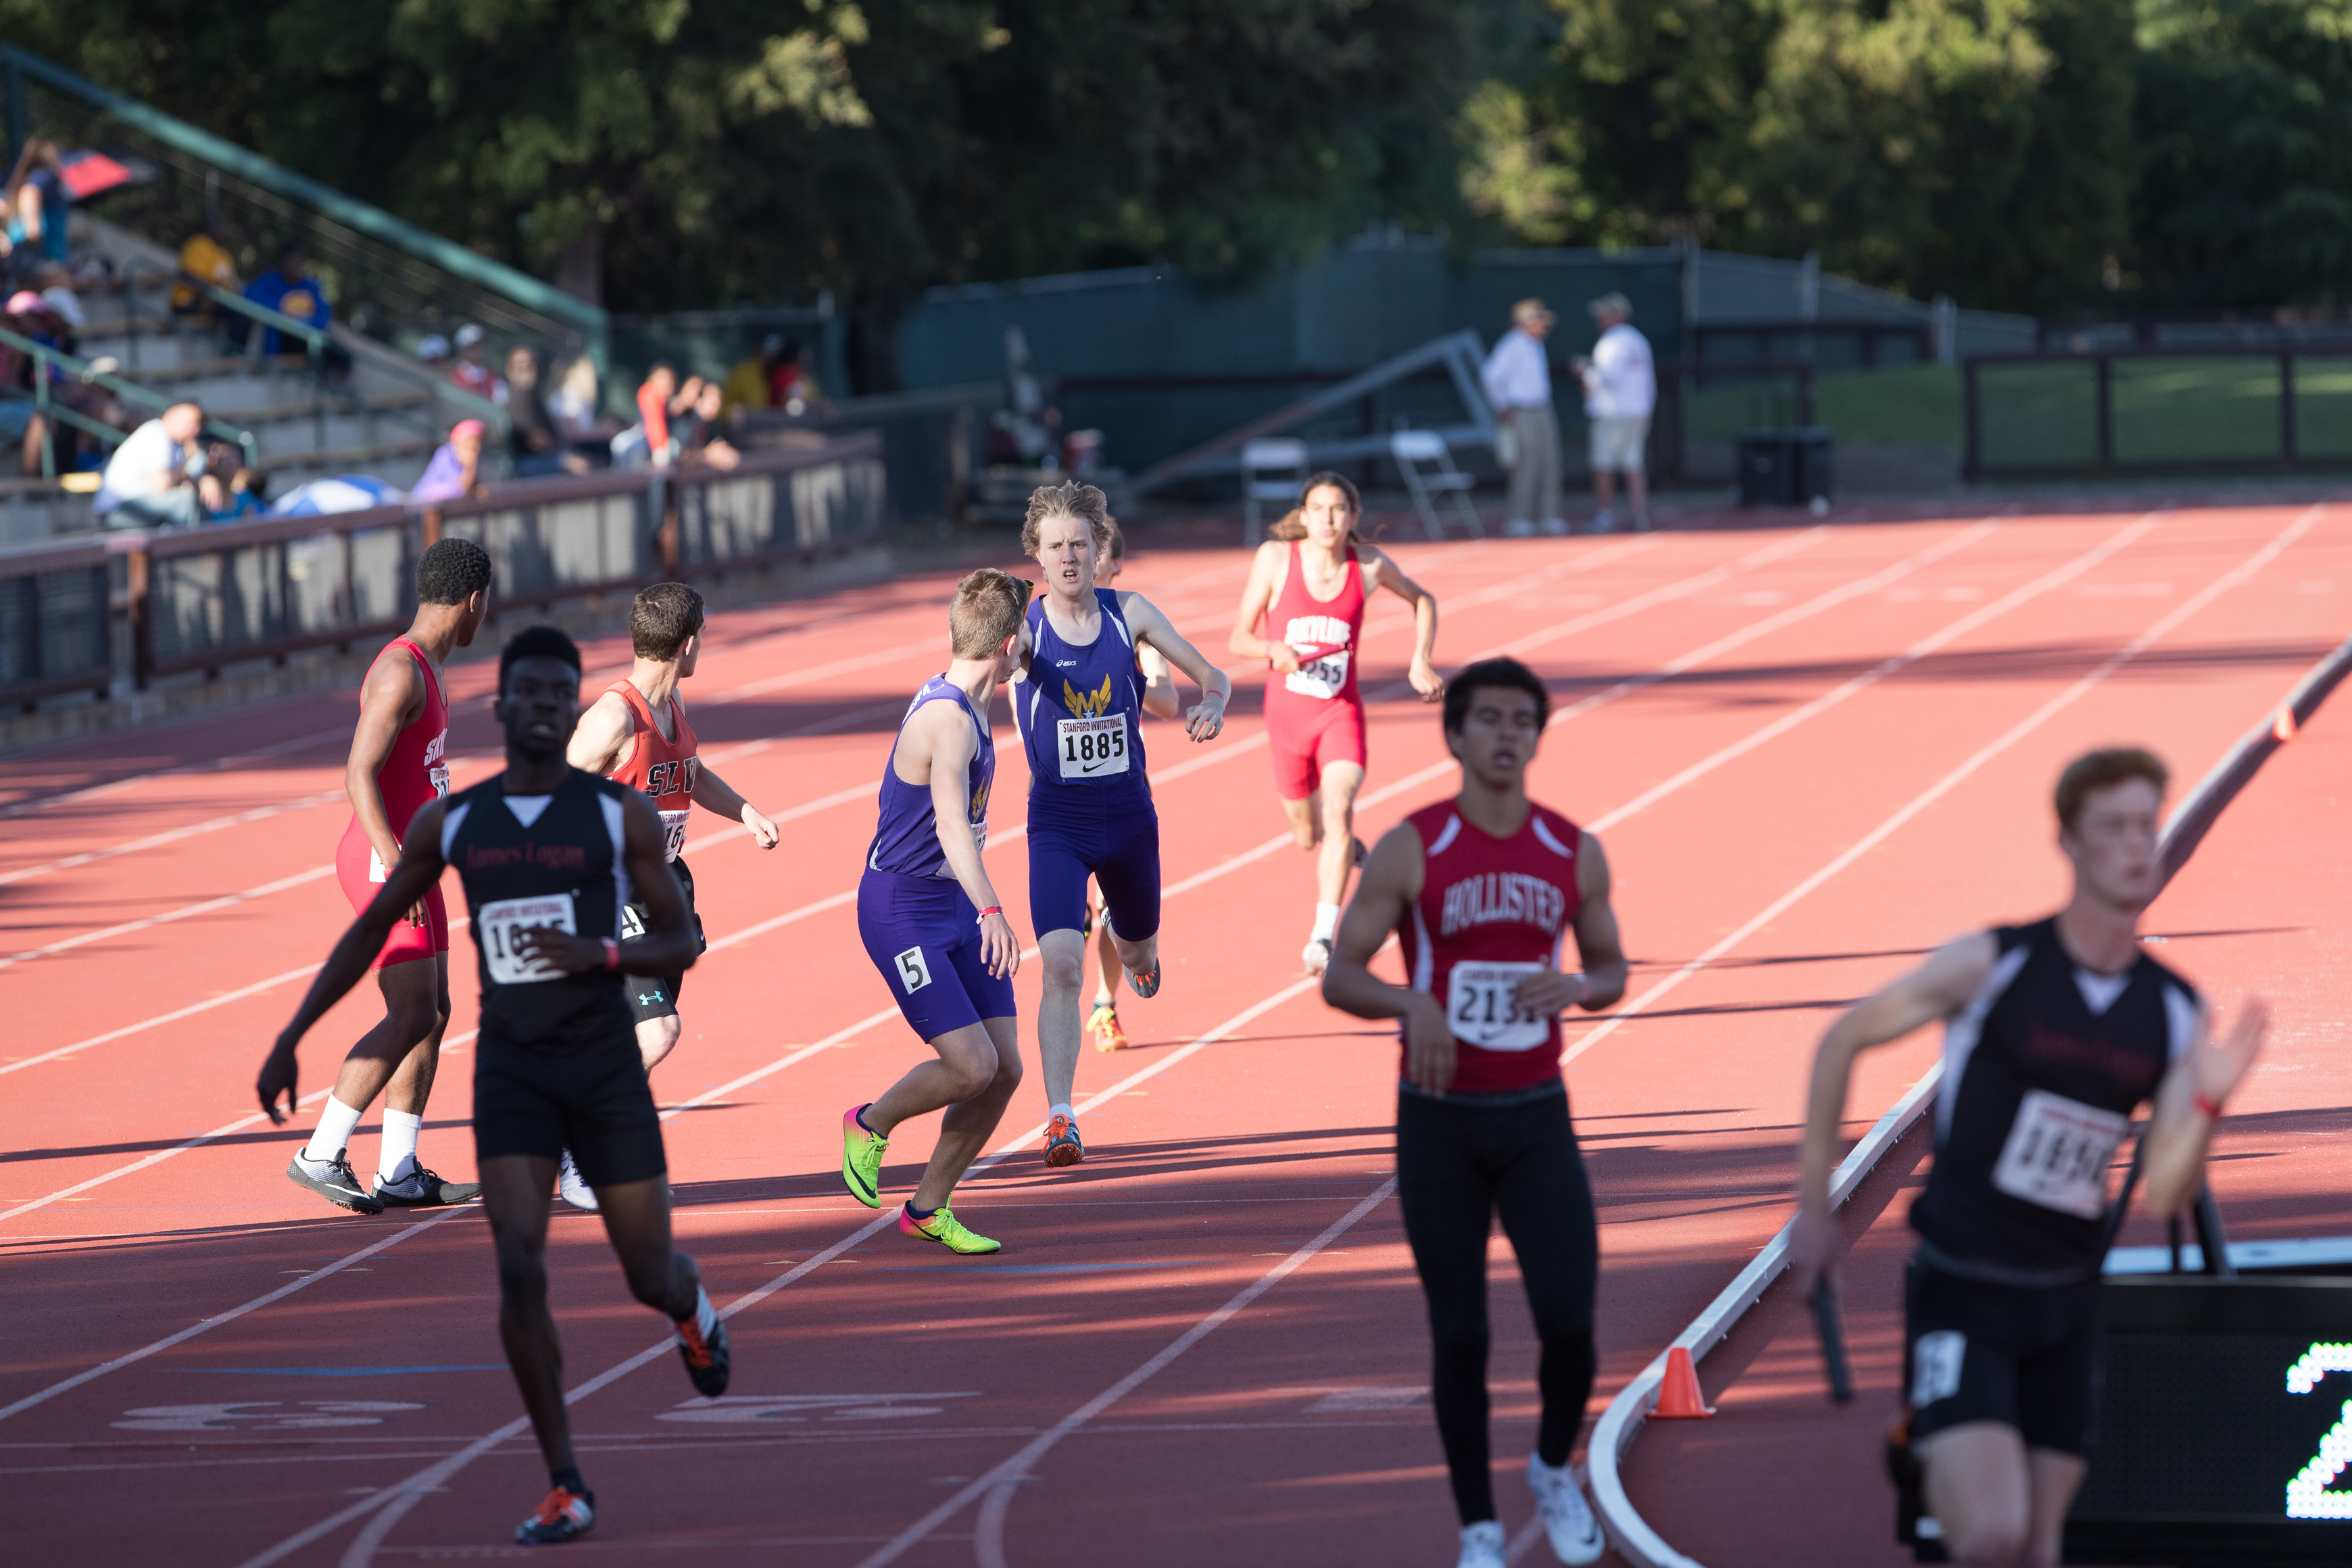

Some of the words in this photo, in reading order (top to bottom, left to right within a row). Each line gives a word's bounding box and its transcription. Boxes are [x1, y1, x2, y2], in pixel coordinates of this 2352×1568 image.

[1063, 721, 1090, 733] STANFORD
[1091, 716, 1123, 732] INVITATIONAL
[1065, 729, 1124, 762] 1885
[644, 756, 698, 798] SLV
[664, 825, 684, 850] 16
[1440, 871, 1565, 936] HOLLISTER
[901, 950, 924, 989] 5
[2286, 1342, 2352, 1519] 2
